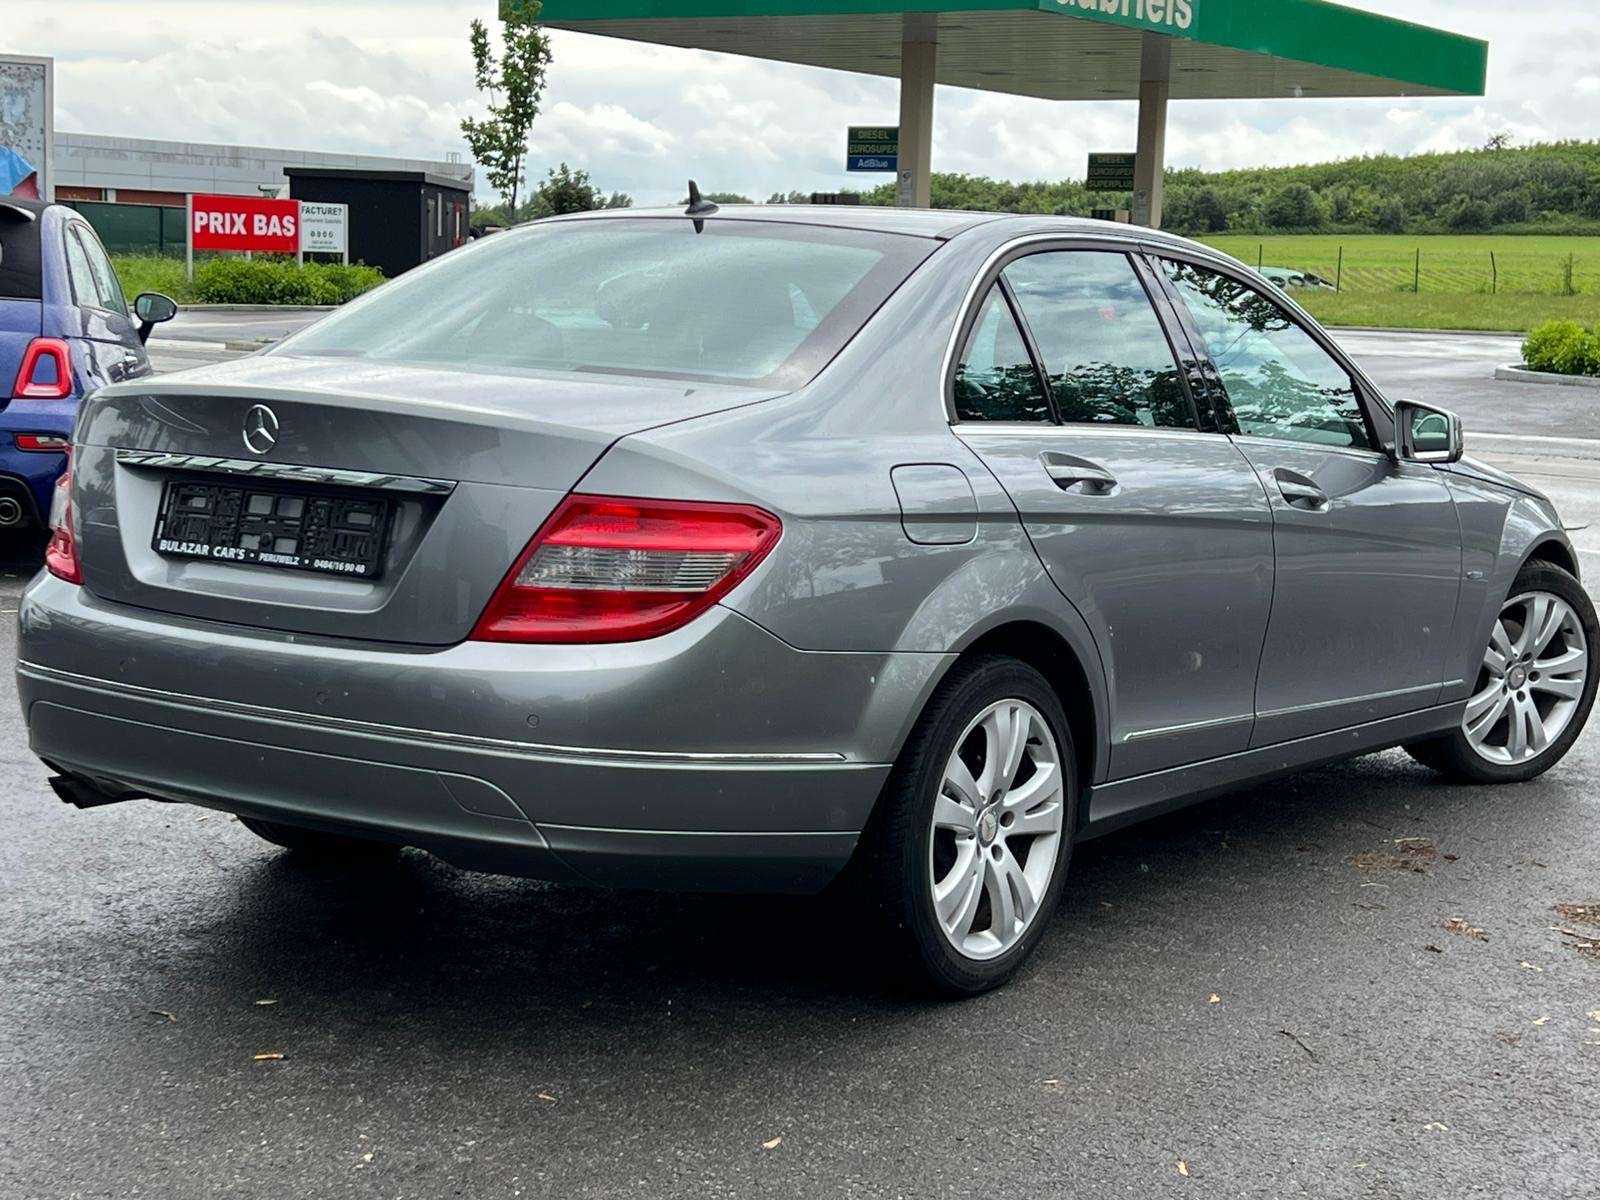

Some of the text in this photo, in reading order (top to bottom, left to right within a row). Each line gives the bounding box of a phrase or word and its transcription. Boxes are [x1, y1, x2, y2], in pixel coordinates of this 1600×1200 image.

[858, 130, 889, 139] DIESEL
[857, 158, 889, 168] AdBlue
[301, 205, 342, 216] FACTURE?
[194, 211, 296, 237] PRIX BAS
[159, 539, 209, 556] BULAZAR
[213, 546, 245, 560] CAR'S
